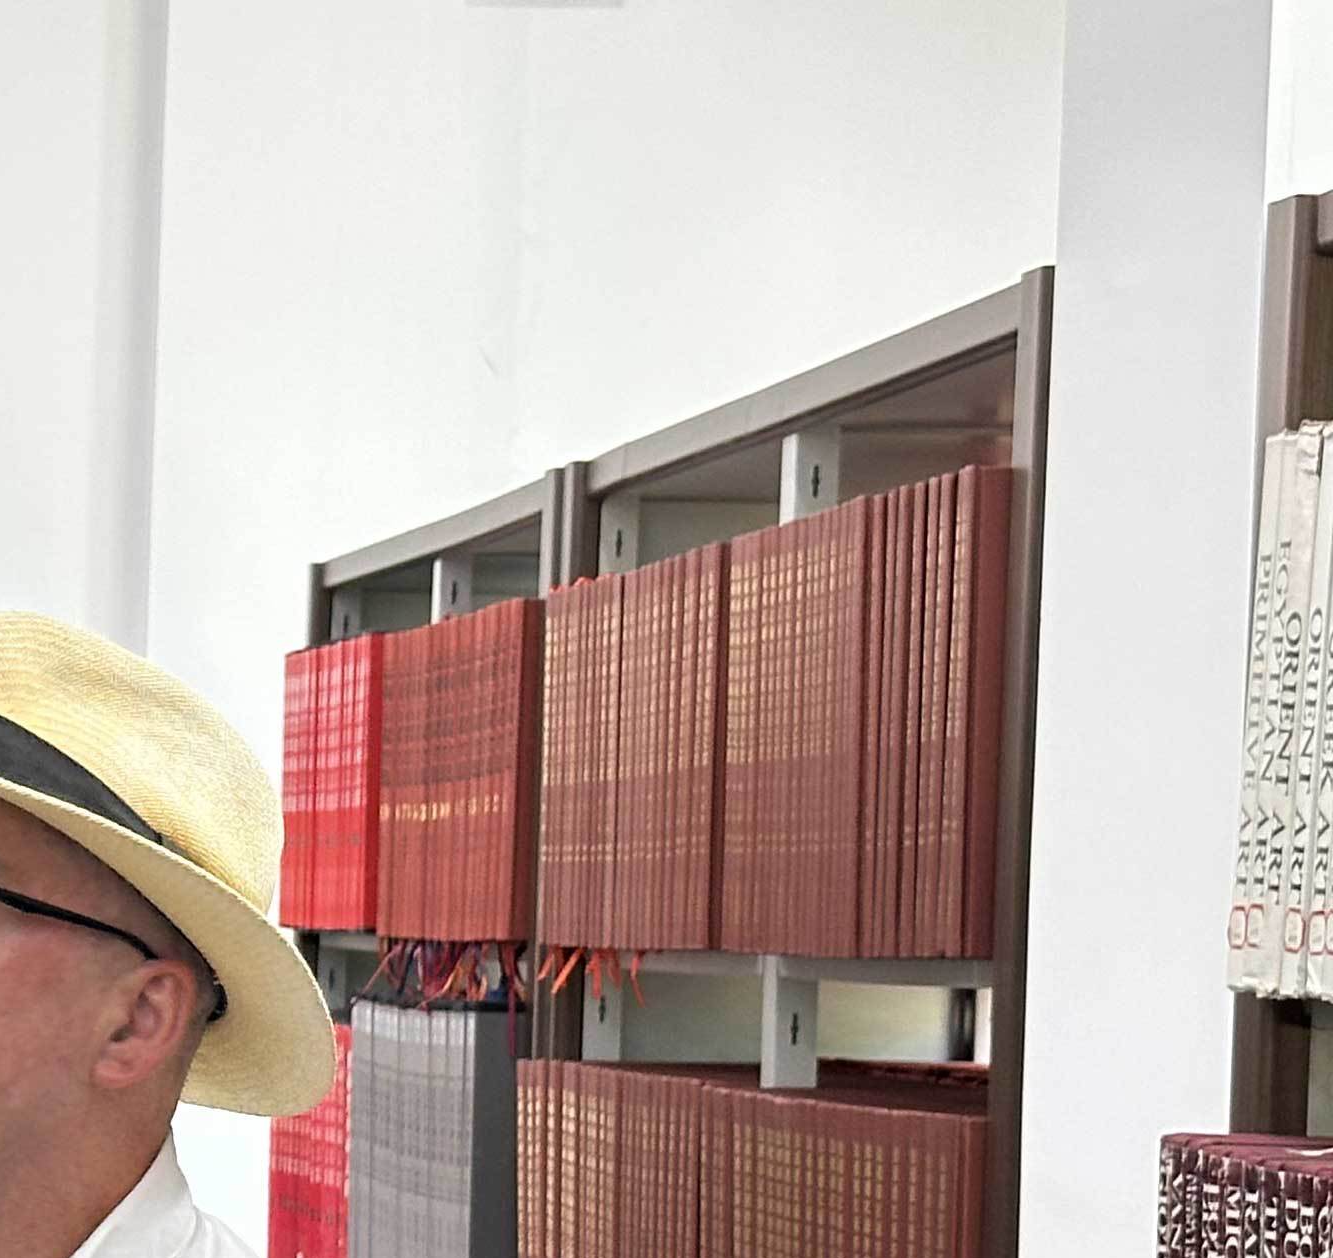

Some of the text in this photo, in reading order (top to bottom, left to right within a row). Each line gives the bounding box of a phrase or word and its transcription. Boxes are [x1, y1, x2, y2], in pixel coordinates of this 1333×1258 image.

[1235, 552, 1272, 897] PRIMITIVE ART
[1253, 539, 1292, 898] EGYPTIAN ART
[1267, 610, 1303, 907] ORIENT ART
[1289, 606, 1323, 906] ORIENT ART
[1314, 809, 1331, 908] ART
[1168, 1173, 1184, 1250] VAN
